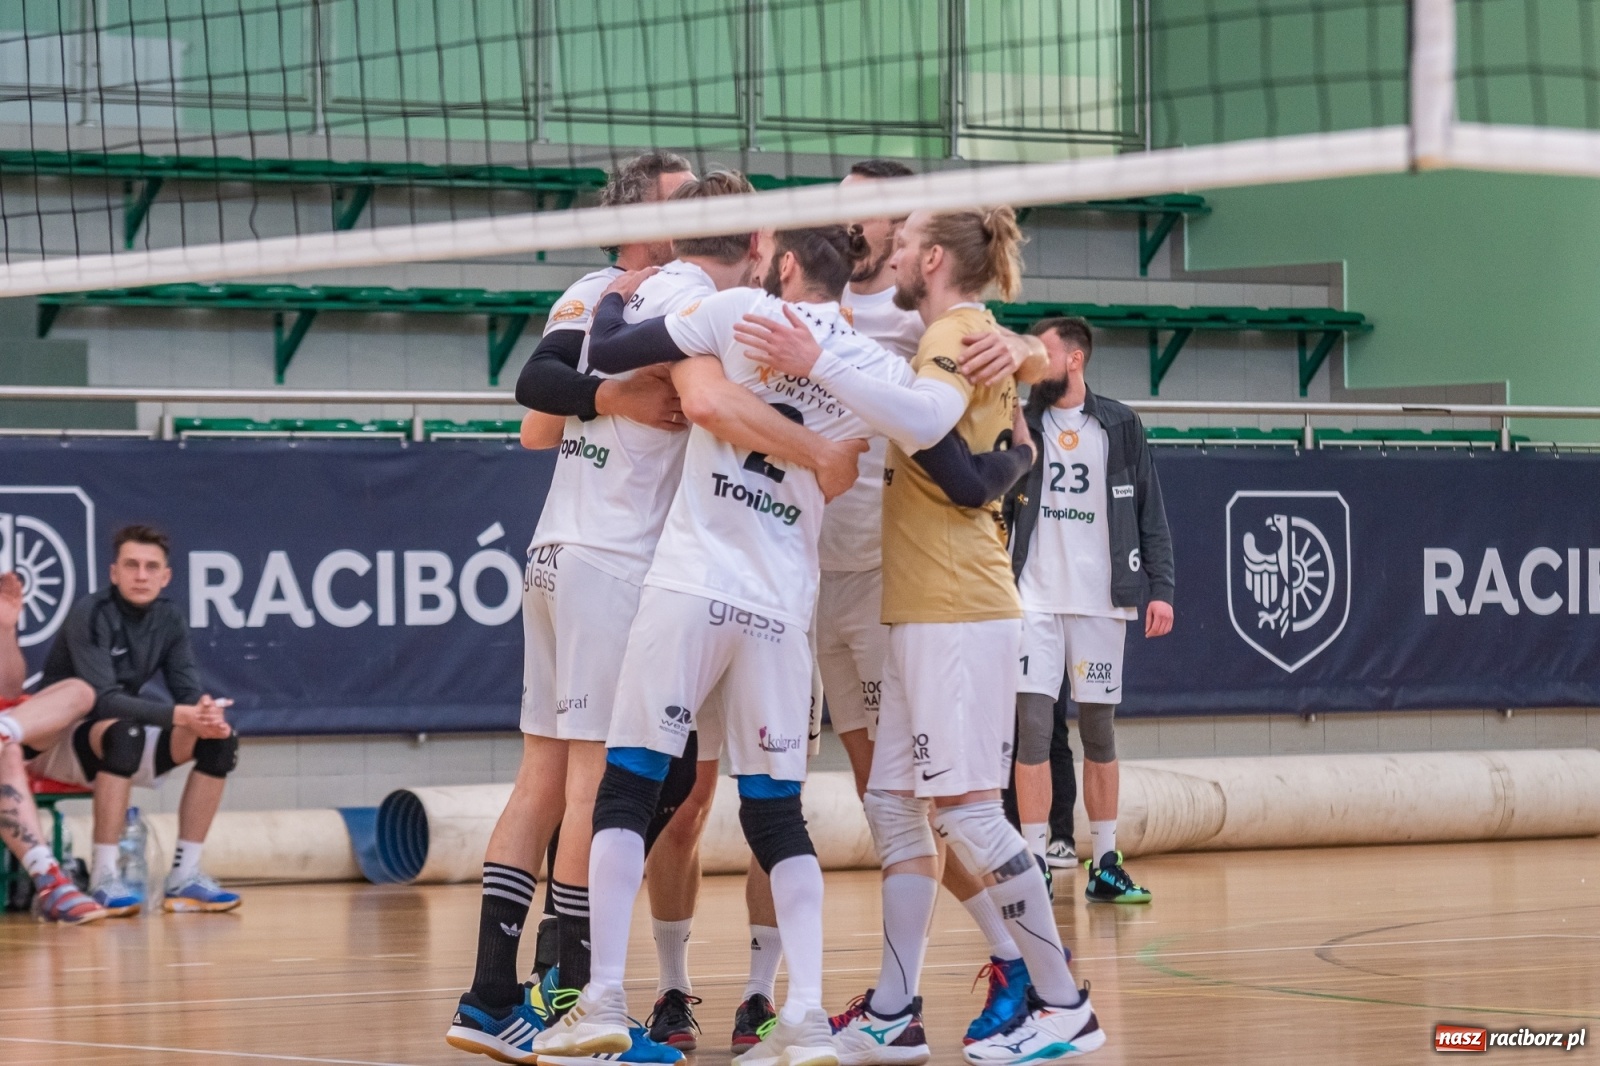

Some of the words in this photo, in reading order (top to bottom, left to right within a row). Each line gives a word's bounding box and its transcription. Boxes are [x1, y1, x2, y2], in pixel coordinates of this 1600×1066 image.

[766, 383, 846, 418] UNATYCY
[1049, 462, 1090, 494] 23
[1041, 506, 1095, 524] TropiDog
[1129, 548, 1140, 572] 6
[1086, 671, 1112, 680] MAR
[1088, 663, 1112, 672] ZOO
